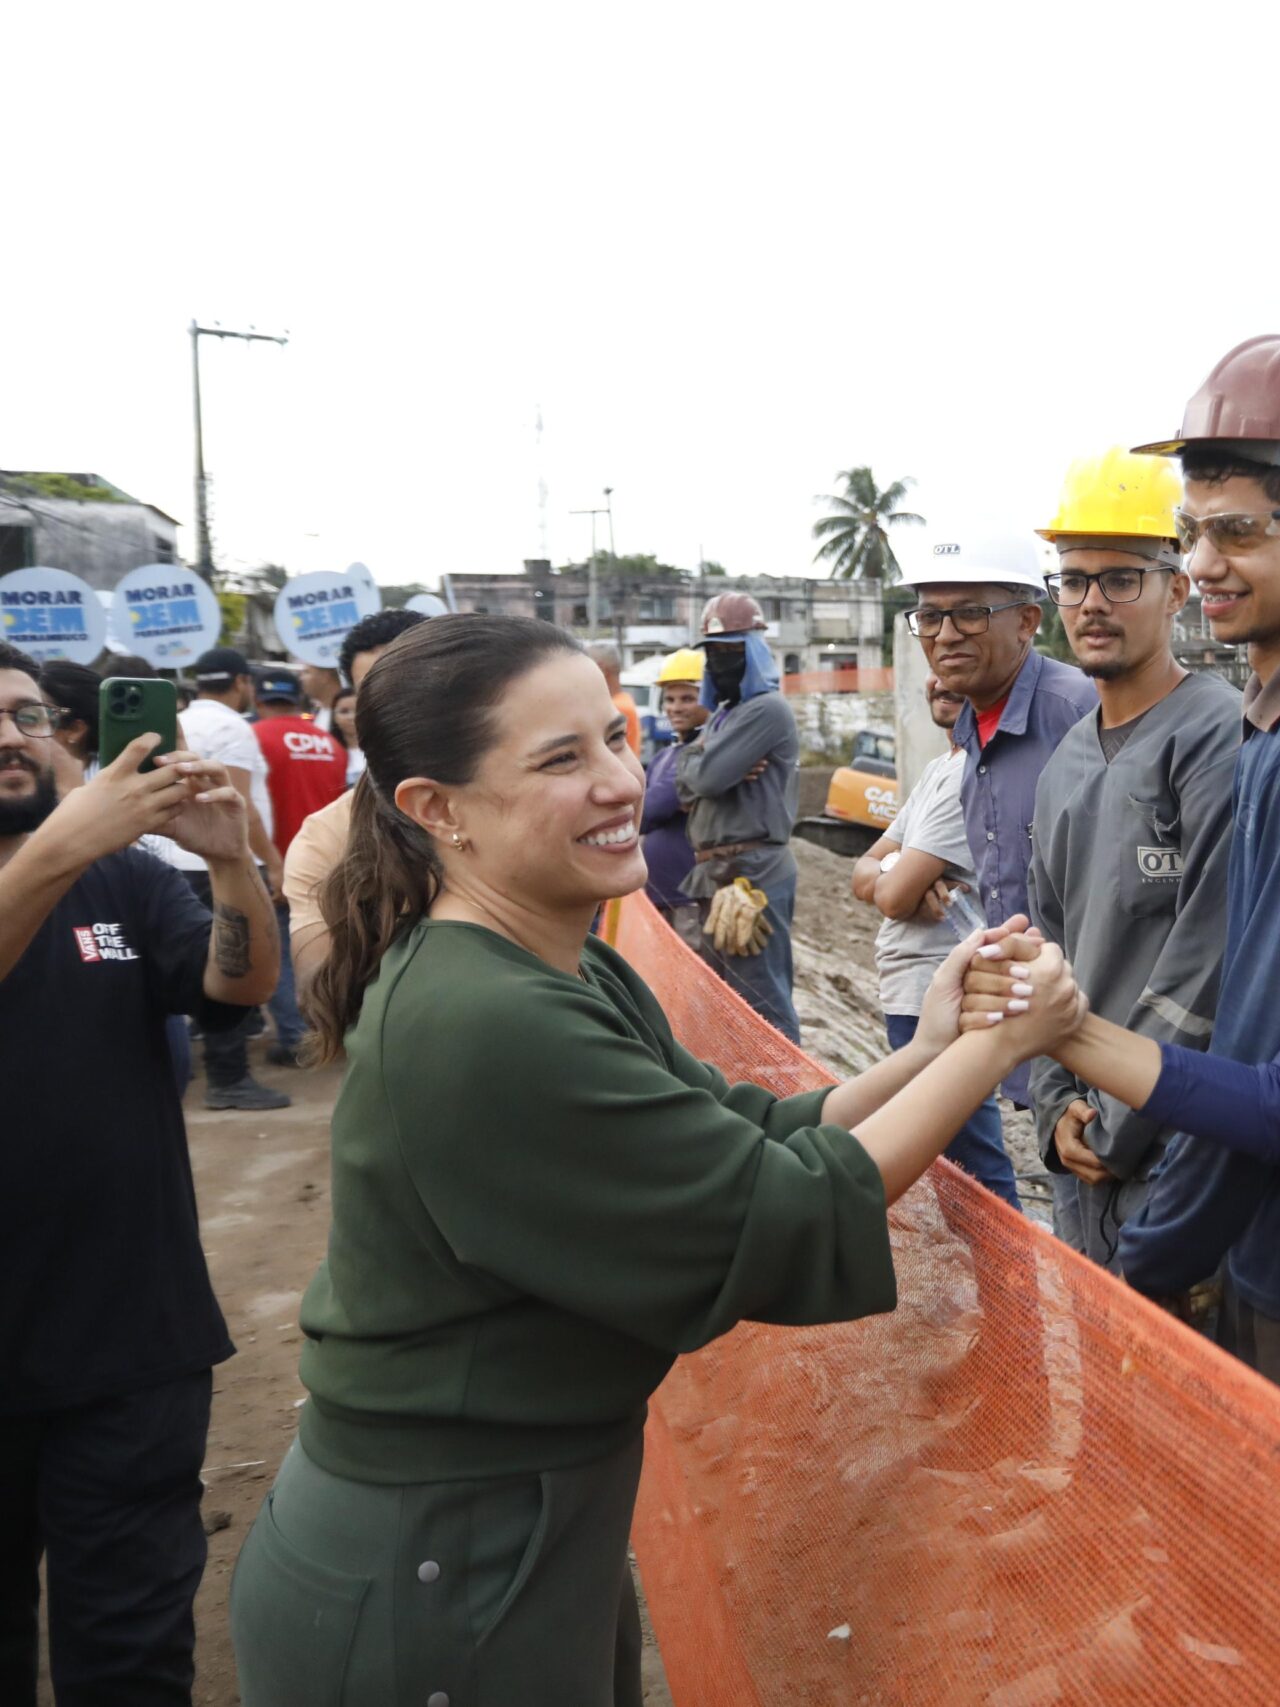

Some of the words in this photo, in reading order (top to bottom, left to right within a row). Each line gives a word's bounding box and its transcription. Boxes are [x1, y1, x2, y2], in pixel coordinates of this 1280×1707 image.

[1, 591, 82, 605] MORAR
[125, 584, 196, 603] MORAR
[287, 586, 354, 609] MORAR
[283, 732, 333, 755] CPM
[864, 786, 897, 806] CA
[1143, 852, 1182, 872] OT
[92, 923, 123, 936] OFF
[76, 930, 97, 960] VANS
[95, 935, 127, 948] THE
[98, 947, 140, 960] WALL
